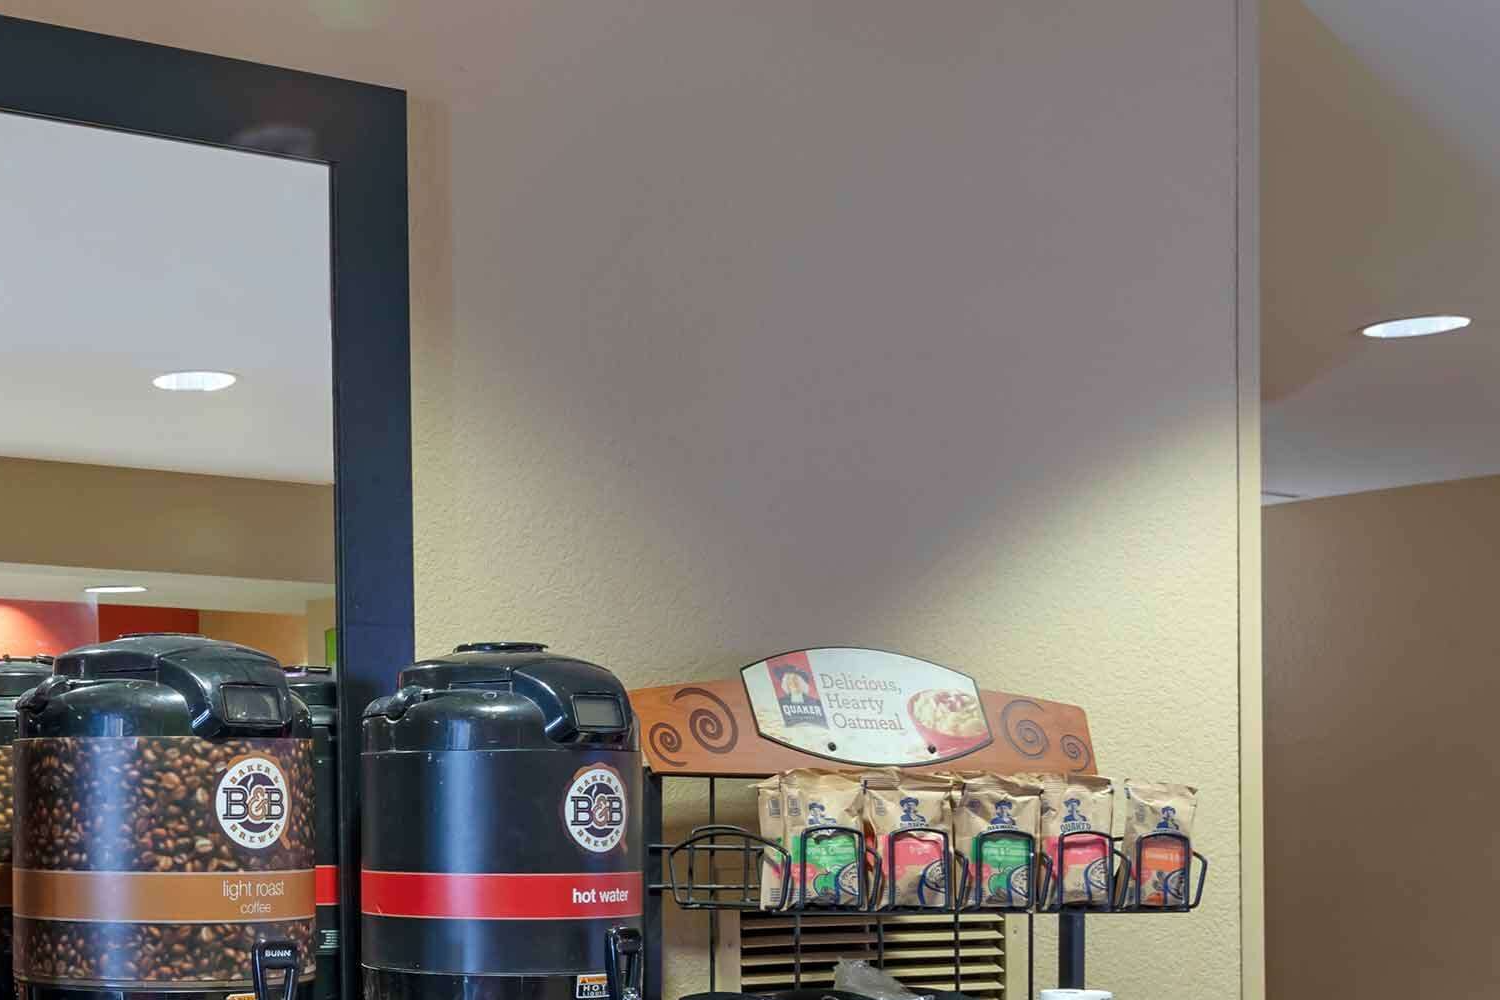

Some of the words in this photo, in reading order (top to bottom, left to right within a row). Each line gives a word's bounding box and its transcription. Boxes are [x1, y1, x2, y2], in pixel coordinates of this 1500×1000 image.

[820, 673, 901, 694] Delicious,
[782, 704, 822, 717] QUAKER
[826, 693, 883, 714] Hearty
[832, 713, 904, 730] Oatmeal
[230, 763, 271, 785] BAKER
[577, 774, 612, 794] BAKER
[222, 785, 284, 820] B&B
[571, 794, 623, 827] B&B
[230, 823, 281, 843] BREWER
[577, 829, 620, 847] BREWER
[223, 880, 252, 901] light
[256, 880, 285, 896] roast
[573, 888, 596, 903] hot
[600, 888, 628, 903] water
[240, 902, 271, 914] coffee
